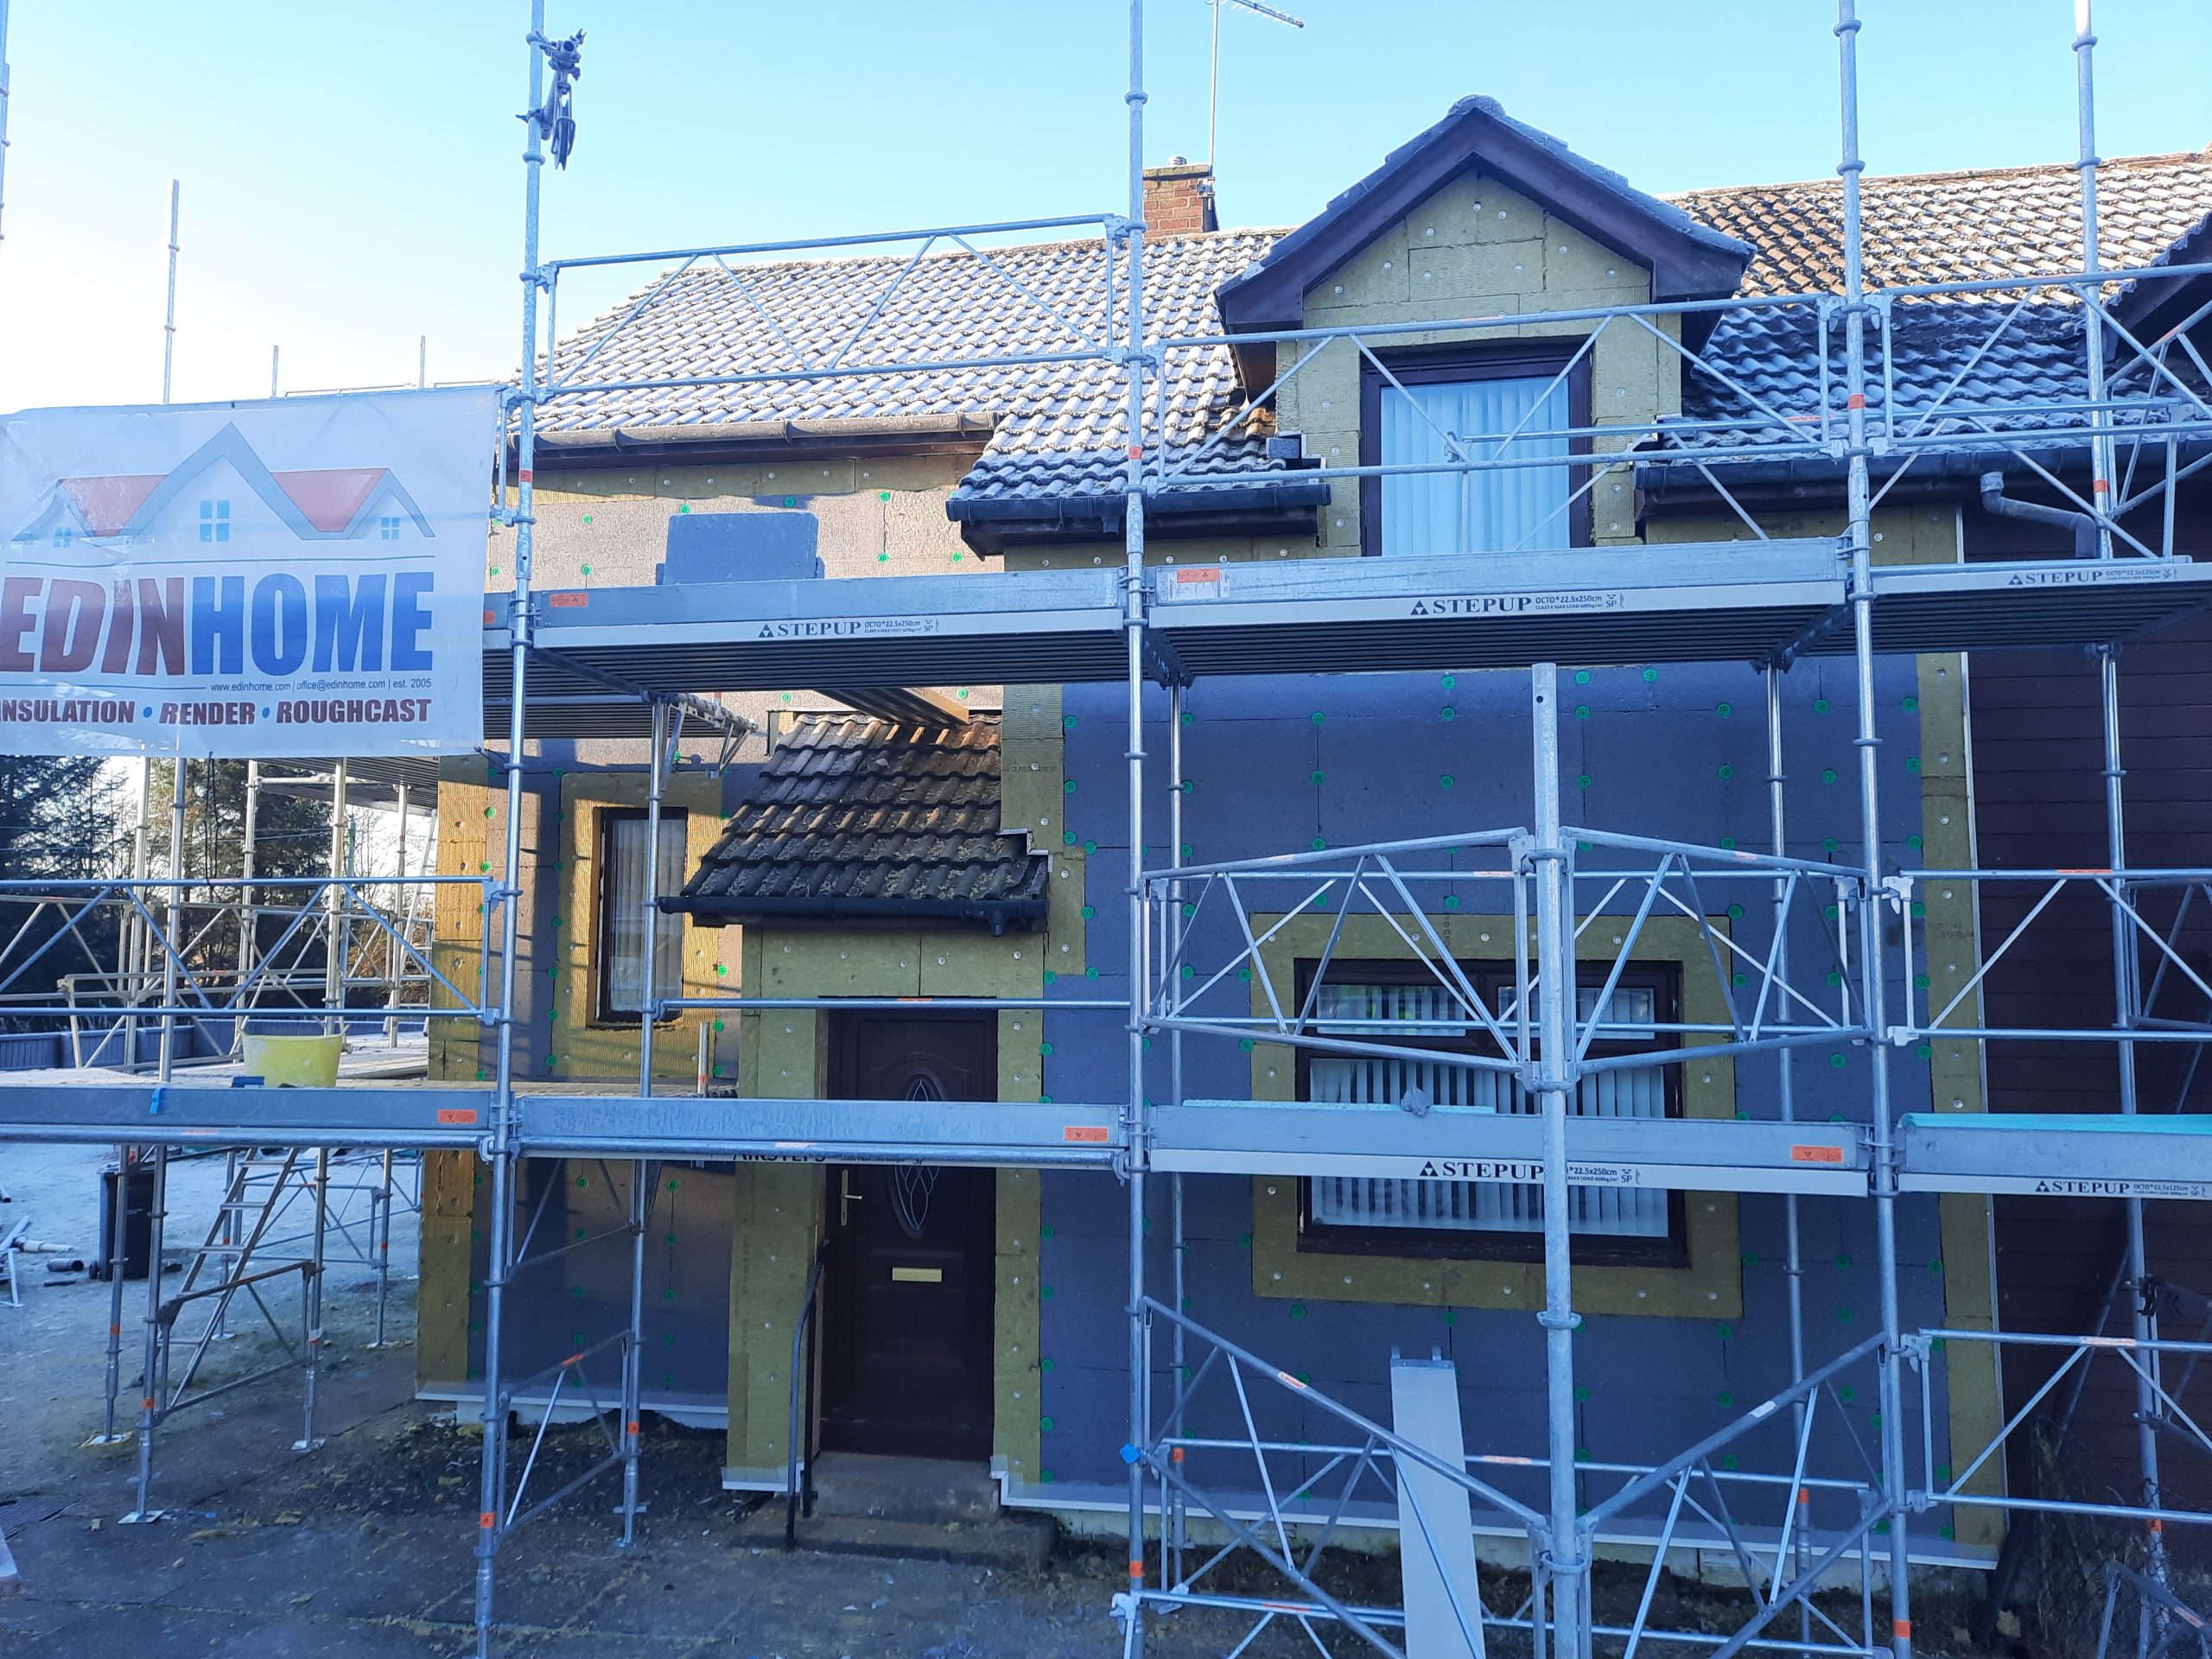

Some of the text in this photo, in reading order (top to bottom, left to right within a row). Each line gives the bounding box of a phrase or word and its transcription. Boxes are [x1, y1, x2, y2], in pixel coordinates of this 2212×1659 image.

[2025, 571, 2103, 584] STEPUP
[1433, 597, 1532, 614] STEPUP
[0, 571, 435, 676] EDINHOME
[778, 621, 861, 637] STEPUP
[210, 677, 432, 692] www.edinhome.com office@edinhome.com est. 2005
[0, 698, 432, 725] NSULATION RENDER ROUGHCAST
[1442, 1162, 1544, 1179] STEPUP
[2052, 1181, 2130, 1194] STEPUP
